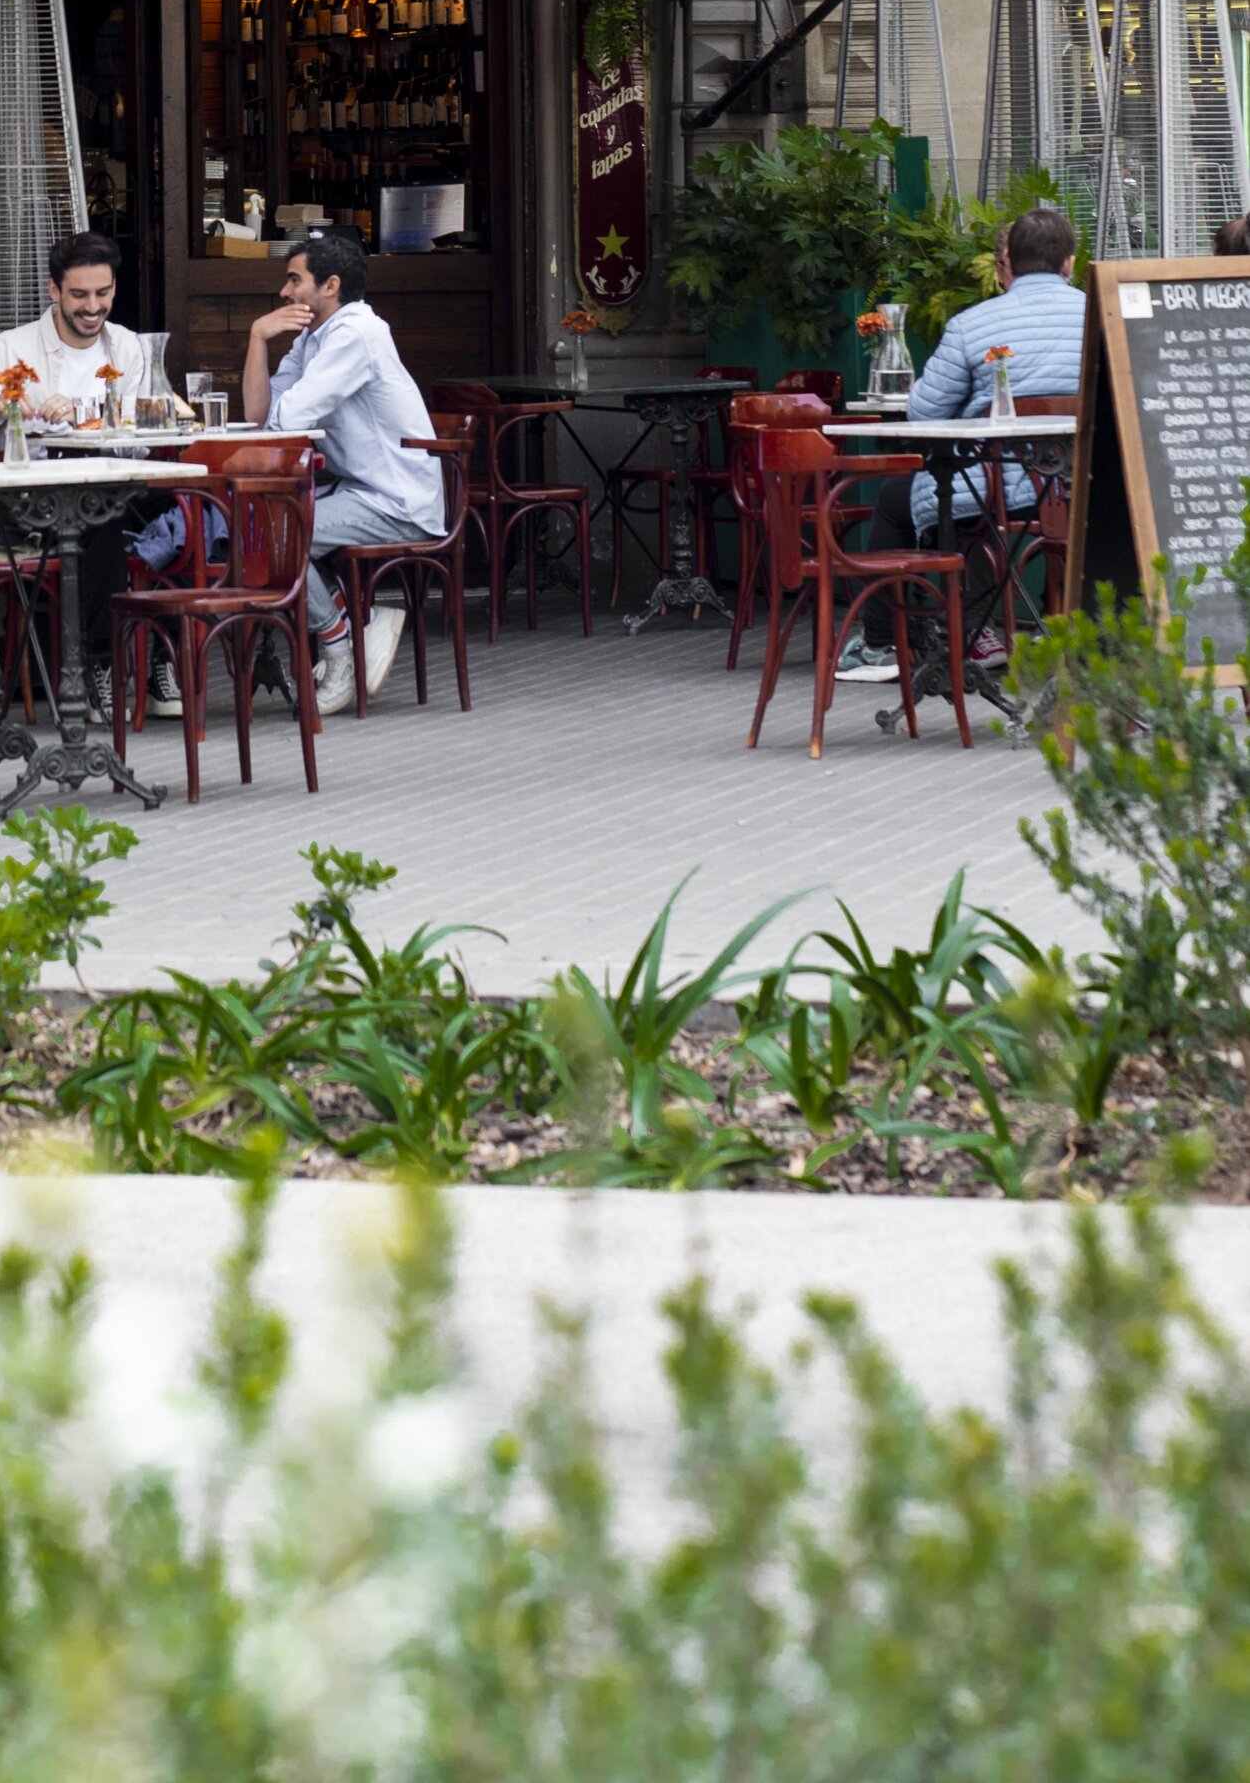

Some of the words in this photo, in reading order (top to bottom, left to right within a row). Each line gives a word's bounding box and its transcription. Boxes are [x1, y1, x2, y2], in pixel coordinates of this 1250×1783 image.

[579, 84, 644, 129] comidas
[606, 124, 617, 146] y
[591, 140, 633, 180] tapas
